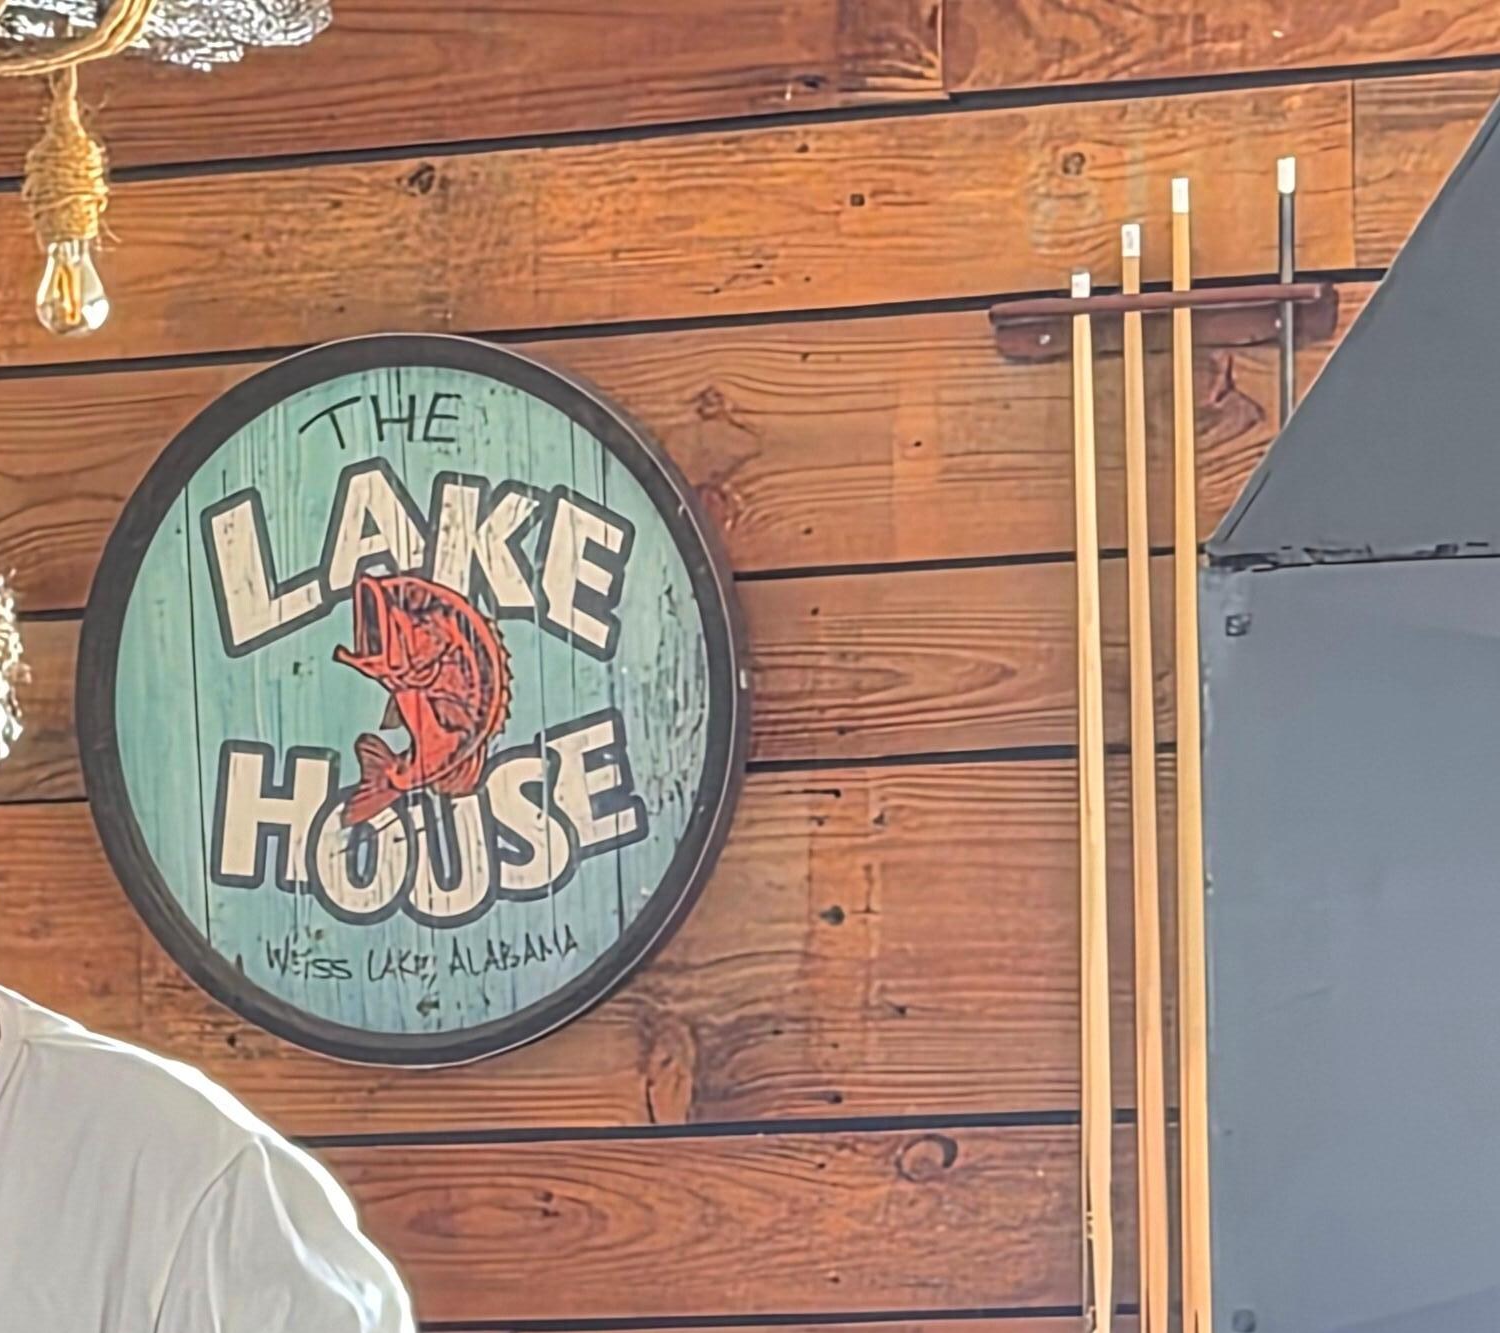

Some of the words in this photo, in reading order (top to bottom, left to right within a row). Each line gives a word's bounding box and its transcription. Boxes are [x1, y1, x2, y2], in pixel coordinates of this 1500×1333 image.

[299, 393, 463, 450] THE
[202, 458, 635, 658] LAKE
[210, 710, 649, 928] HOUSE
[266, 935, 353, 980] WEISS
[450, 923, 579, 978] ALABAMA
